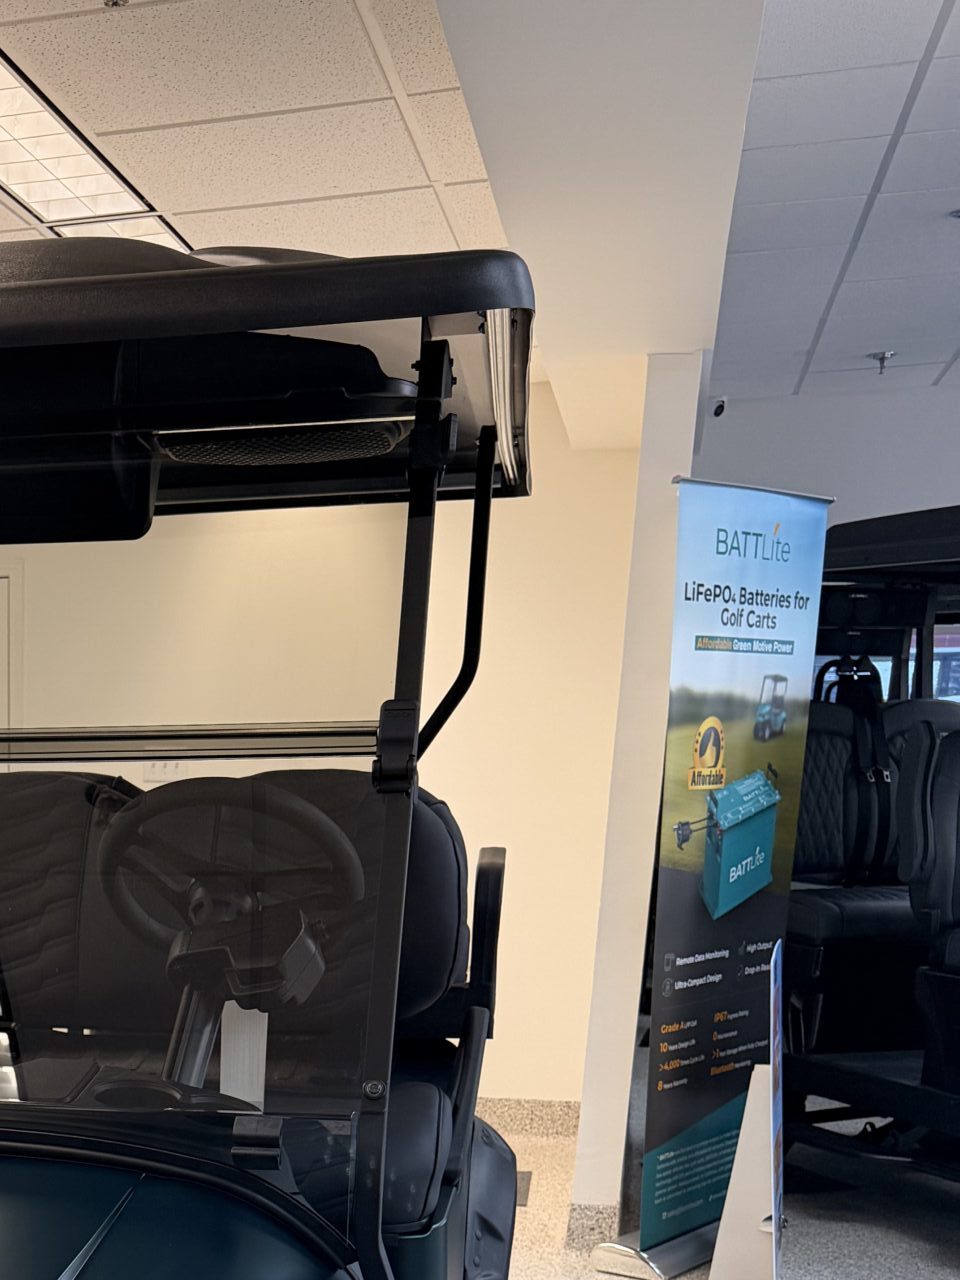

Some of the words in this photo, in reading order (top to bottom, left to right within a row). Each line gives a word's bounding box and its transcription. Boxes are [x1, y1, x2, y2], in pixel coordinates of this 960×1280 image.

[715, 522, 791, 562] BATTLite
[739, 587, 792, 609] Batteries
[794, 590, 810, 610] for
[720, 607, 745, 627] Golf
[746, 609, 777, 629] Carts
[696, 637, 732, 650] Affordable
[732, 639, 752, 651] Green
[752, 640, 773, 652] Motive
[773, 641, 793, 653] Power
[690, 770, 724, 787] Affordable
[729, 846, 765, 883] BATTLite
[660, 1021, 680, 1034] Grade
[659, 1041, 668, 1053] 10
